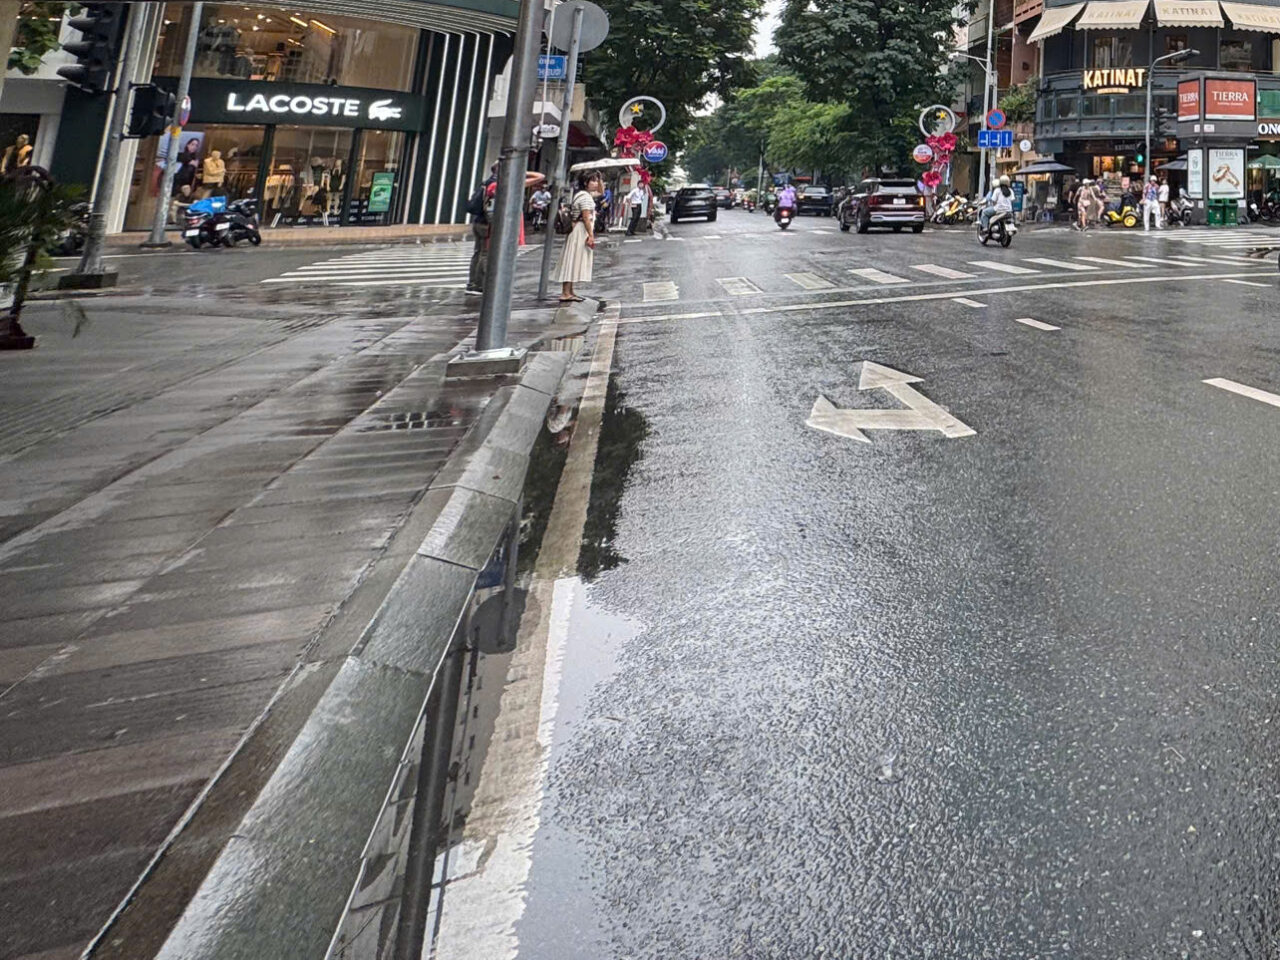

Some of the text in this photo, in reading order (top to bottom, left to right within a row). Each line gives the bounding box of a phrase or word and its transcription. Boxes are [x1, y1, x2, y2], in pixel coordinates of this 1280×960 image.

[1162, 6, 1213, 16] KATINAT
[1084, 69, 1145, 89] KATINAT
[1179, 91, 1199, 102] TIERRA
[1211, 90, 1249, 102] TIERRA
[226, 92, 361, 117] LACOSTE
